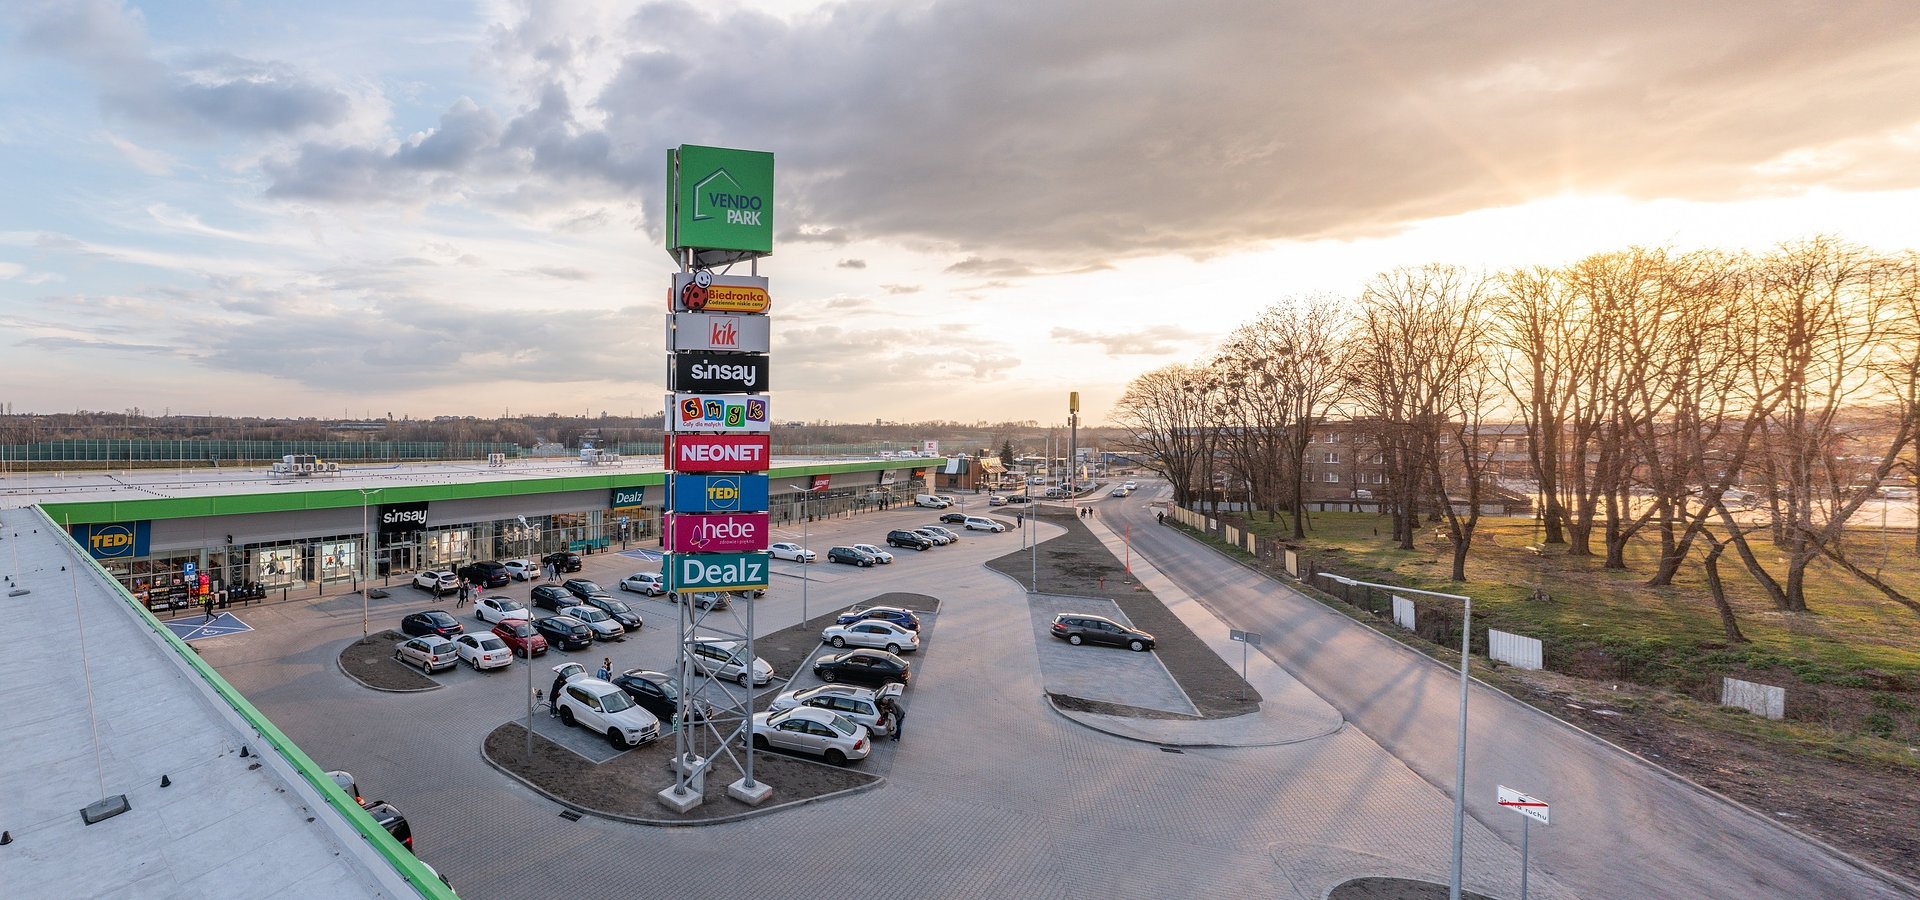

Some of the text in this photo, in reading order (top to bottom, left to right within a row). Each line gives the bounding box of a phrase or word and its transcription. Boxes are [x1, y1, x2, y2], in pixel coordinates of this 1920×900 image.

[709, 193, 762, 210] VENDO
[727, 209, 762, 226] PARK
[709, 290, 764, 303] Biedronka
[691, 359, 756, 386] sinsay
[681, 444, 764, 461] NEONET
[616, 491, 643, 504] Dealz
[707, 487, 739, 500] TEDi
[382, 508, 428, 525] sinsay
[702, 517, 755, 539] hebe
[91, 533, 133, 548] TEDi
[186, 564, 193, 572] P
[683, 557, 762, 585] Dealz
[1500, 797, 1547, 821] Sta ruchu
